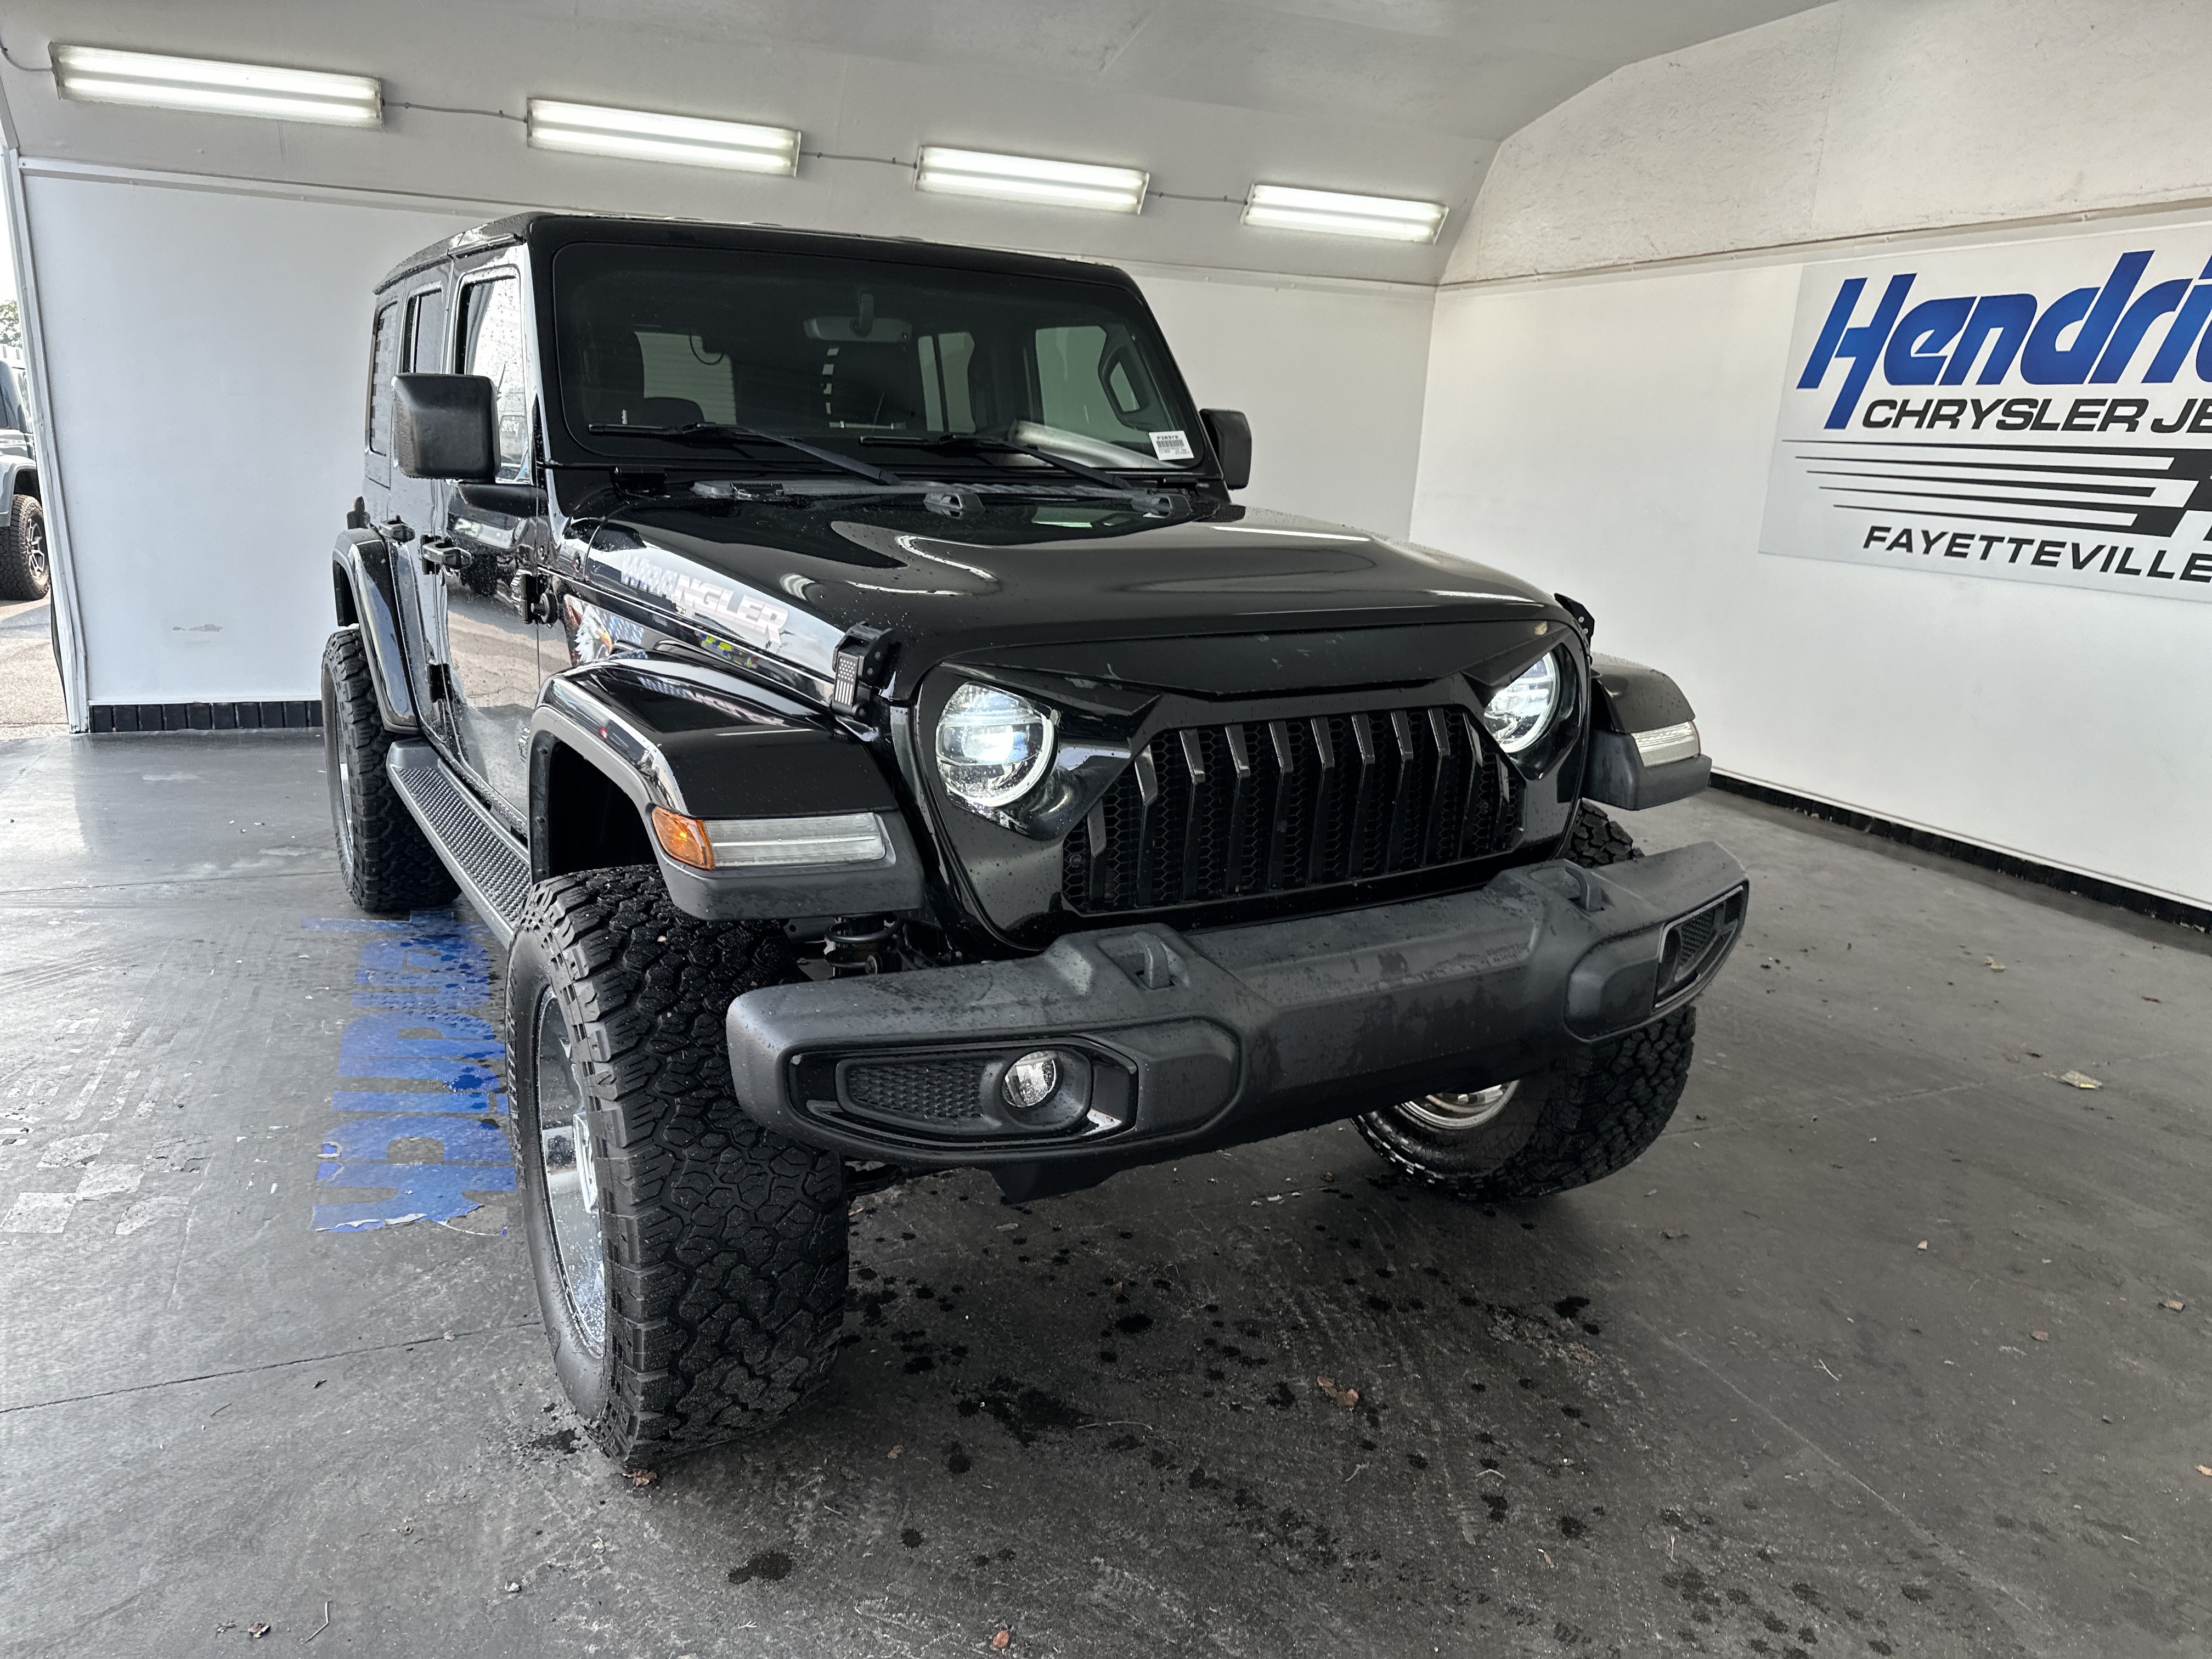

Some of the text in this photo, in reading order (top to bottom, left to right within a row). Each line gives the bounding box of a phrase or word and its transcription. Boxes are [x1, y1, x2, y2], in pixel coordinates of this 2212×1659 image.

[1796, 250, 2212, 429] Hendri
[1862, 398, 2150, 433] CHRYSLER
[1863, 526, 2212, 583] FAYETTEVILLE
[620, 552, 788, 645] WRANGLER
